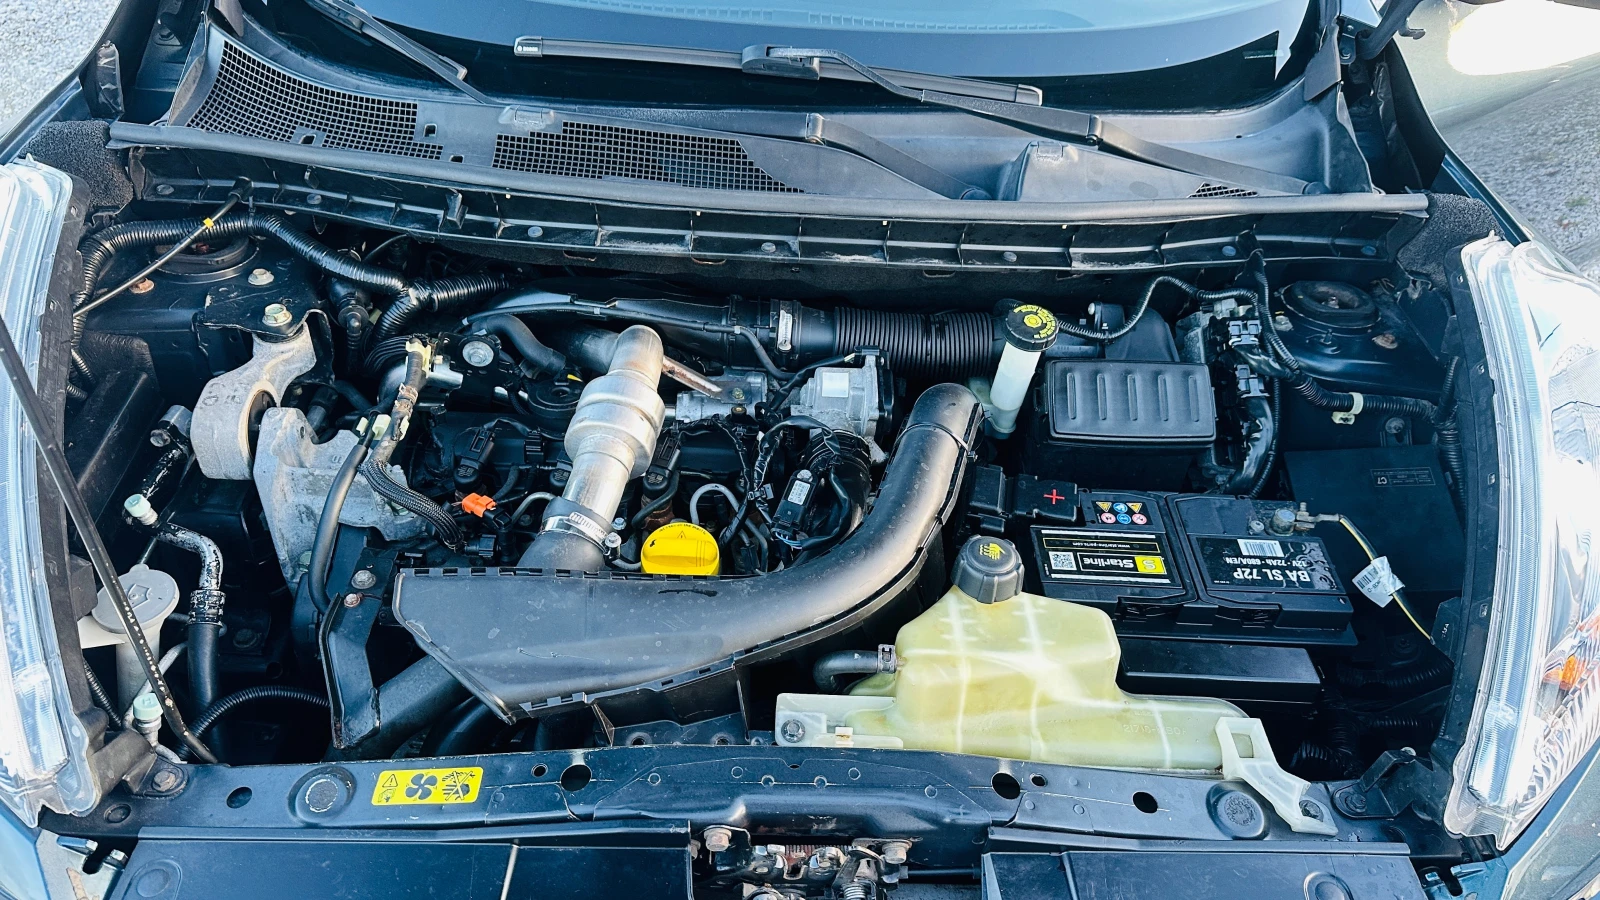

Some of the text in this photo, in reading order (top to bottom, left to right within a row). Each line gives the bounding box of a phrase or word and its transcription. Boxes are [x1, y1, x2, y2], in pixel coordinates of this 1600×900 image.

[1083, 557, 1135, 568] Starline
[1225, 557, 1261, 565] 680A/EN
[1265, 559, 1287, 567] 72Ah
[1233, 567, 1311, 582] BA SL 72P
